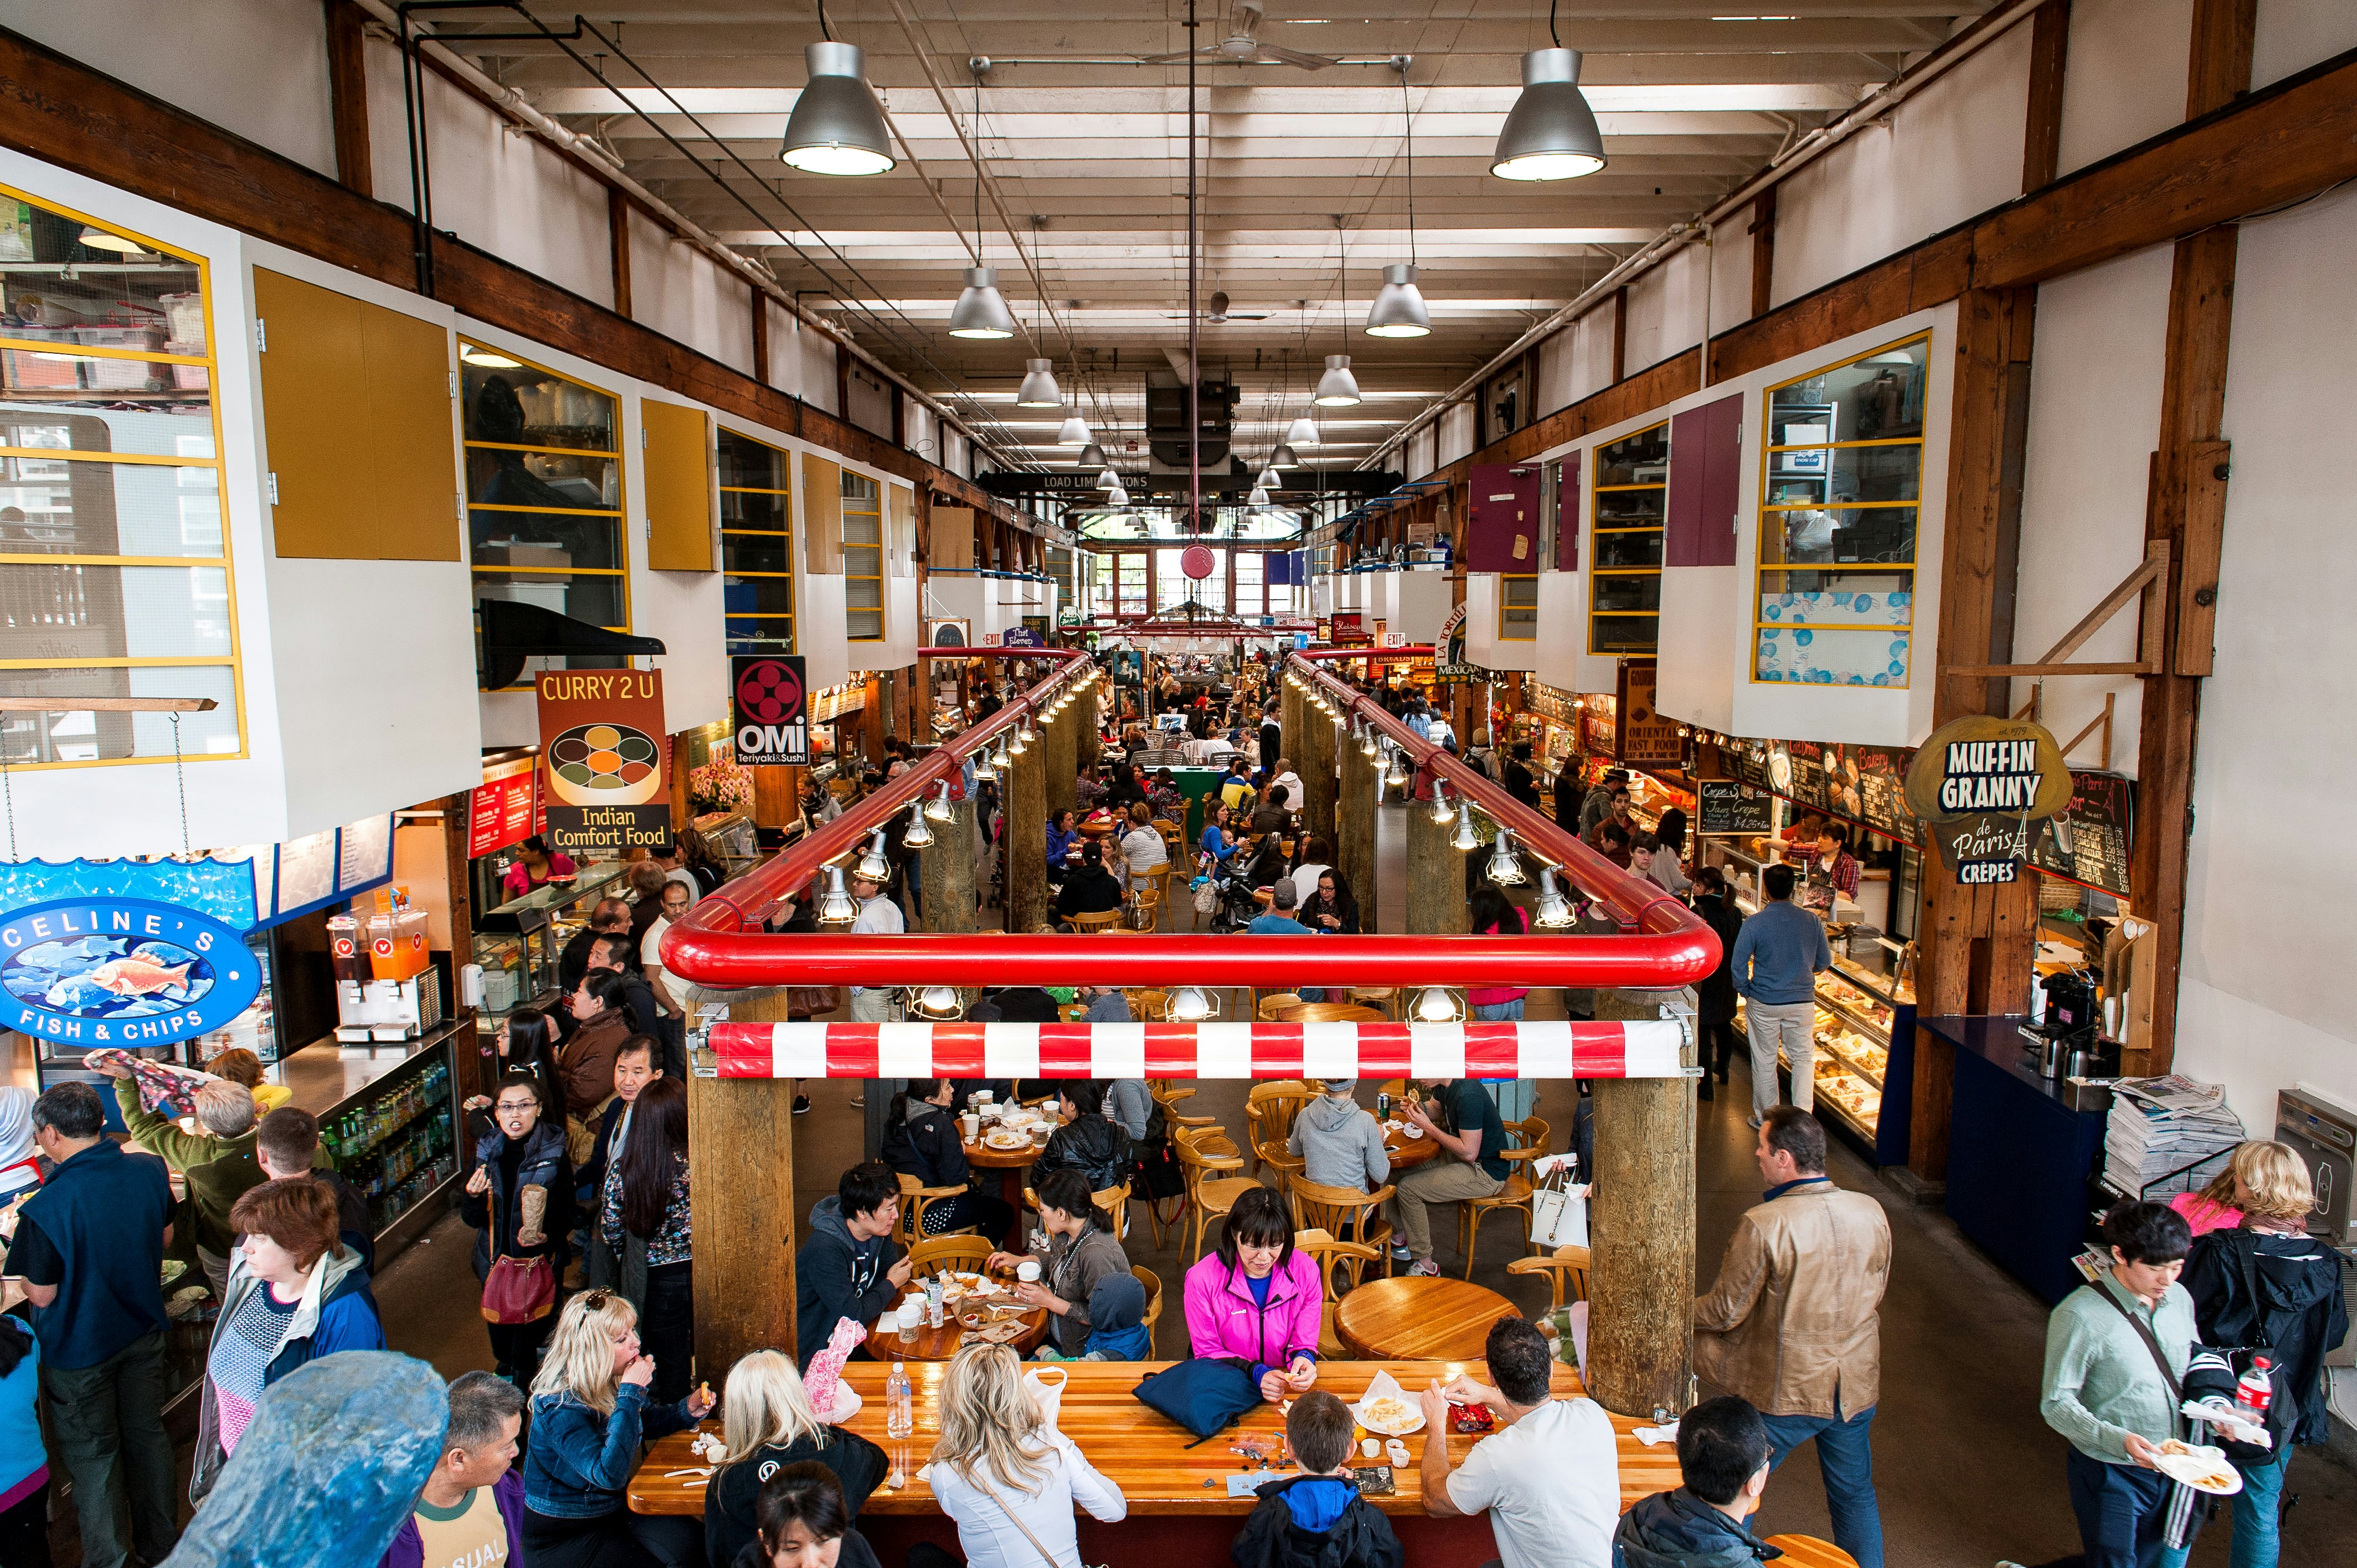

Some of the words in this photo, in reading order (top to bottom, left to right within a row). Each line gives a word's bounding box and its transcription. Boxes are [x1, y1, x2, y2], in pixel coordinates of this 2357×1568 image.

[1044, 477, 1071, 487] LOAD
[1120, 477, 1147, 487] TONS
[986, 634, 1000, 644] EXIT
[1008, 636, 1033, 644] Eleven
[1388, 635, 1402, 644] EXIT
[1438, 645, 1446, 659] LA
[1439, 666, 1481, 674] MEXICAN
[543, 676, 611, 700] CURRY
[620, 678, 632, 699] 2
[640, 675, 654, 699] U
[1629, 727, 1679, 737] ORIENTAL
[1628, 740, 1649, 750] FAST
[1654, 740, 1678, 750] FOOD
[738, 753, 806, 764] Teriyaki&Sushi
[1858, 747, 1888, 774] Bakery
[1948, 741, 2036, 773] MUFFIN
[1703, 783, 1728, 798] Crepe
[1942, 775, 2041, 809] GRANNY
[583, 808, 635, 826] Indian
[1706, 801, 1728, 813] Jam
[1732, 800, 1761, 817] Crepe
[554, 827, 621, 846] Comfort
[626, 827, 665, 845] Food
[1977, 818, 1990, 837] de
[1953, 832, 2012, 859] Paris
[1961, 861, 2014, 884] CRÊPES
[2, 910, 214, 951] CELINE'S
[20, 1009, 81, 1039] FISH
[95, 1024, 110, 1040] &
[123, 1010, 203, 1039] CHIPS
[441, 1539, 505, 1568] SUAL
